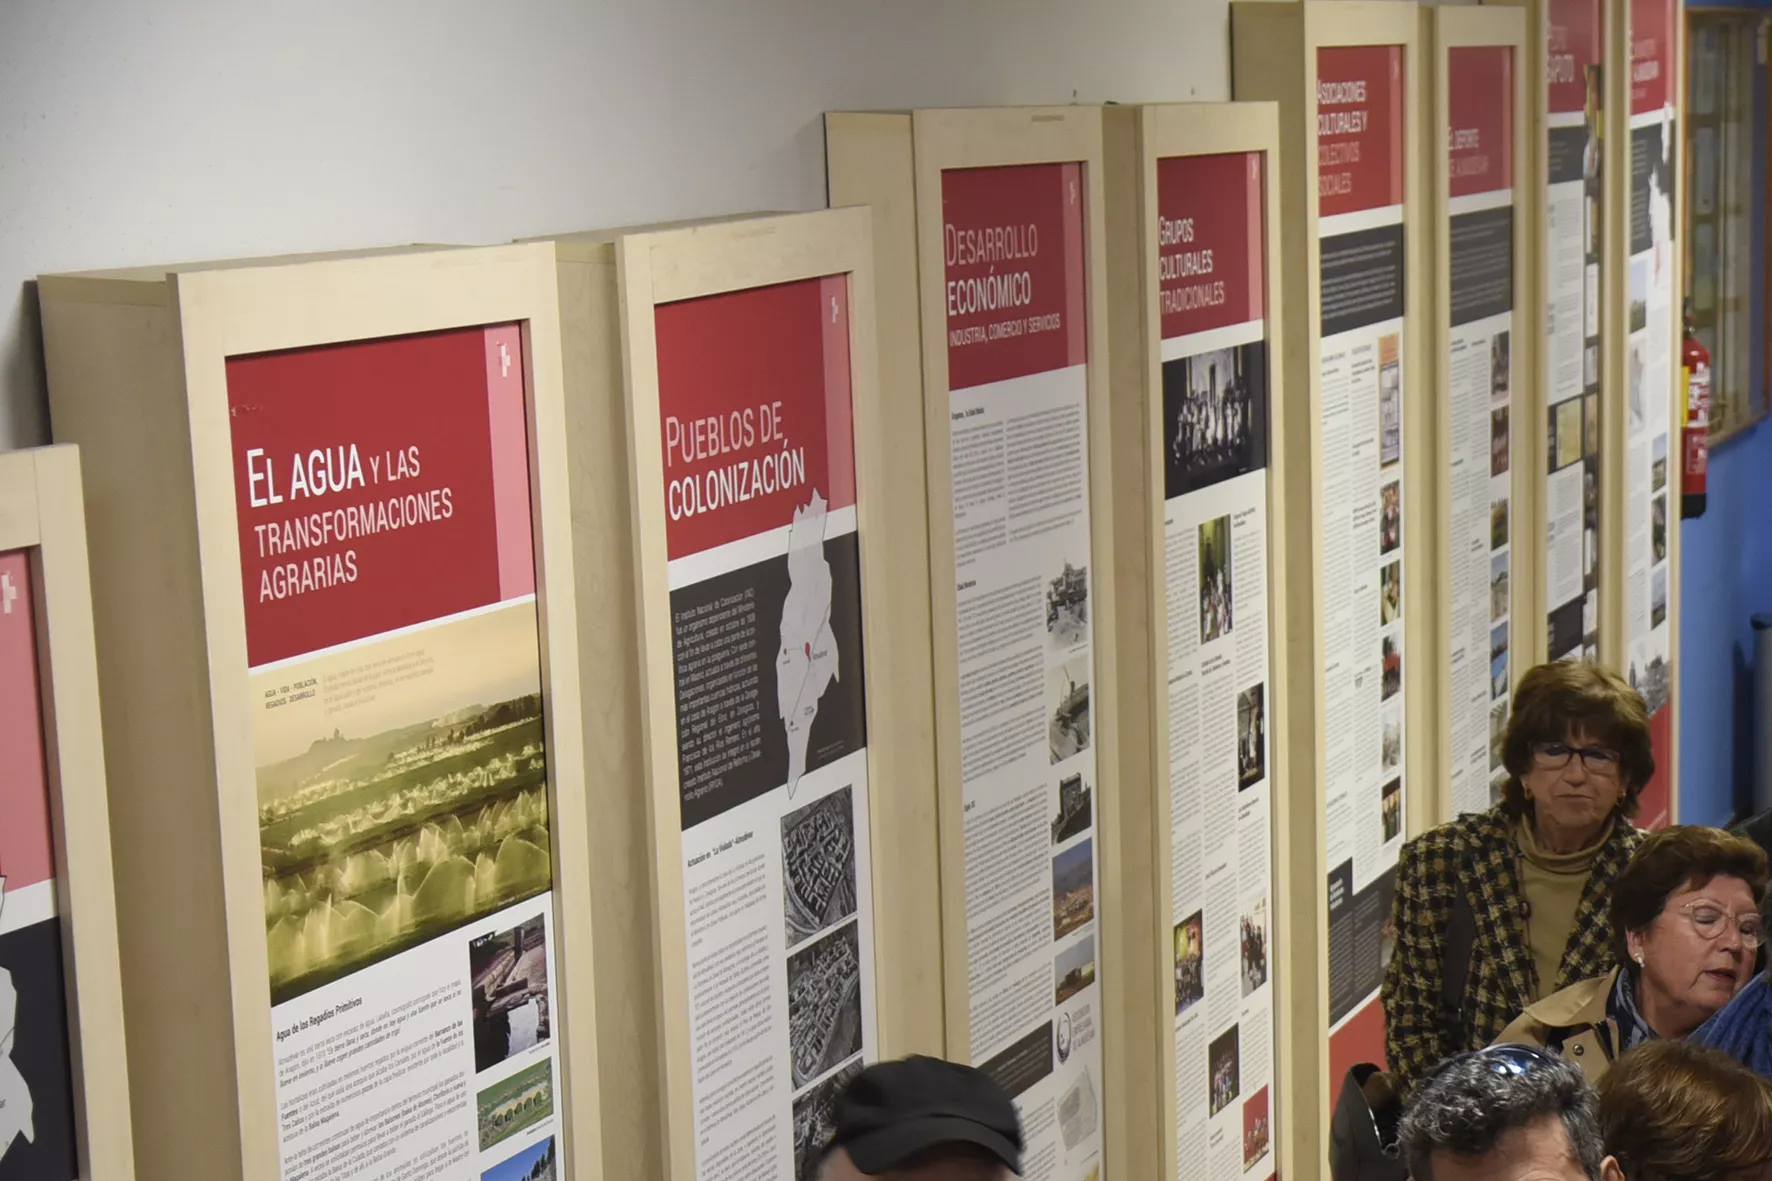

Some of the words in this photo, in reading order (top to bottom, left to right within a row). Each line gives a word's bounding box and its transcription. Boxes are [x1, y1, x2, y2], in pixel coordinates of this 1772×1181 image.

[1160, 249, 1213, 280] CULTURALES
[948, 265, 1031, 317] ECONÓMICO
[1160, 280, 1225, 315] TRADICIONALES
[989, 319, 1022, 341] COMERCIO
[1028, 312, 1061, 334] SERVICIOS
[760, 400, 784, 444] DE
[290, 443, 366, 500] AGUA
[369, 455, 380, 484] Y
[386, 445, 421, 482] LAS
[668, 438, 806, 521] COLONIZACIÓN
[254, 487, 453, 558] TRANSFORMACIONES
[259, 550, 358, 603] AGRARIAS
[276, 1025, 290, 1043] Agua
[291, 1020, 298, 1034] de
[299, 1018, 308, 1031] los
[309, 1005, 334, 1029] Regadíos
[335, 994, 362, 1015] Primitivos
